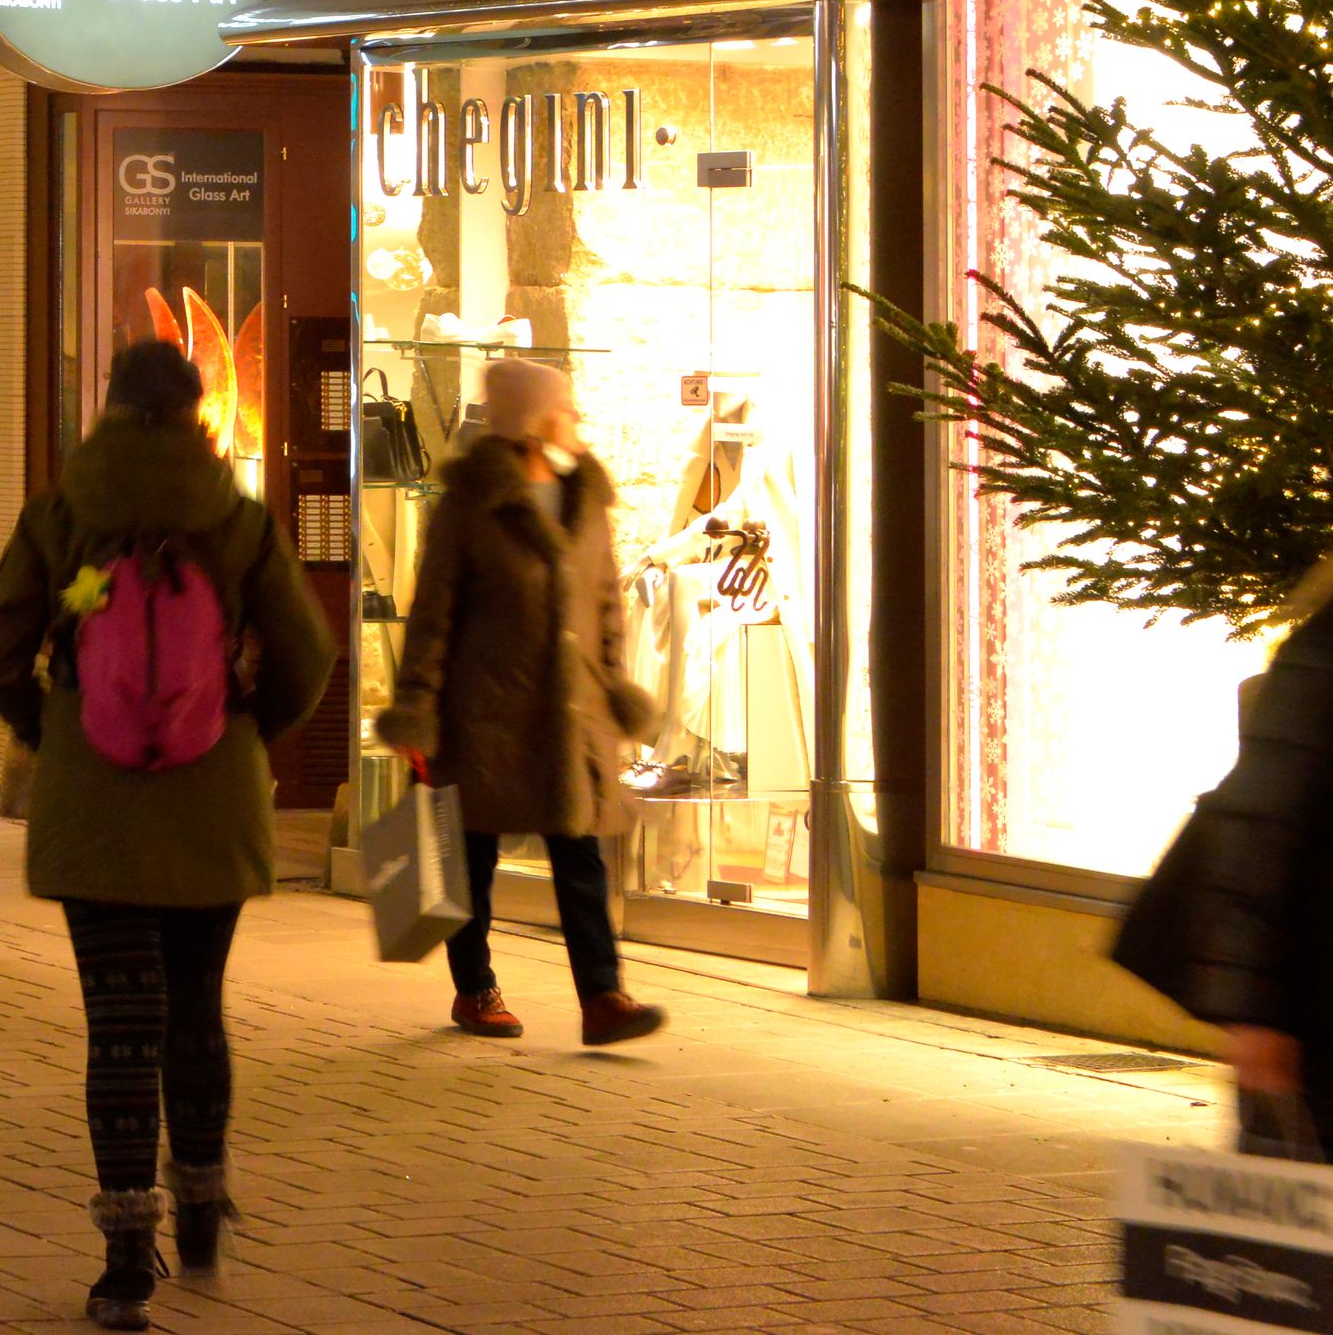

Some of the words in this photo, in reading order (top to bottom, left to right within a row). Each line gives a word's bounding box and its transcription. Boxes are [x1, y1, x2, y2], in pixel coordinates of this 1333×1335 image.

[118, 154, 176, 195] GS
[181, 171, 258, 184] International
[124, 196, 171, 205] GALLERY
[188, 187, 226, 201] Glass
[229, 188, 251, 202] Art
[124, 207, 171, 216] SIKABONYI
